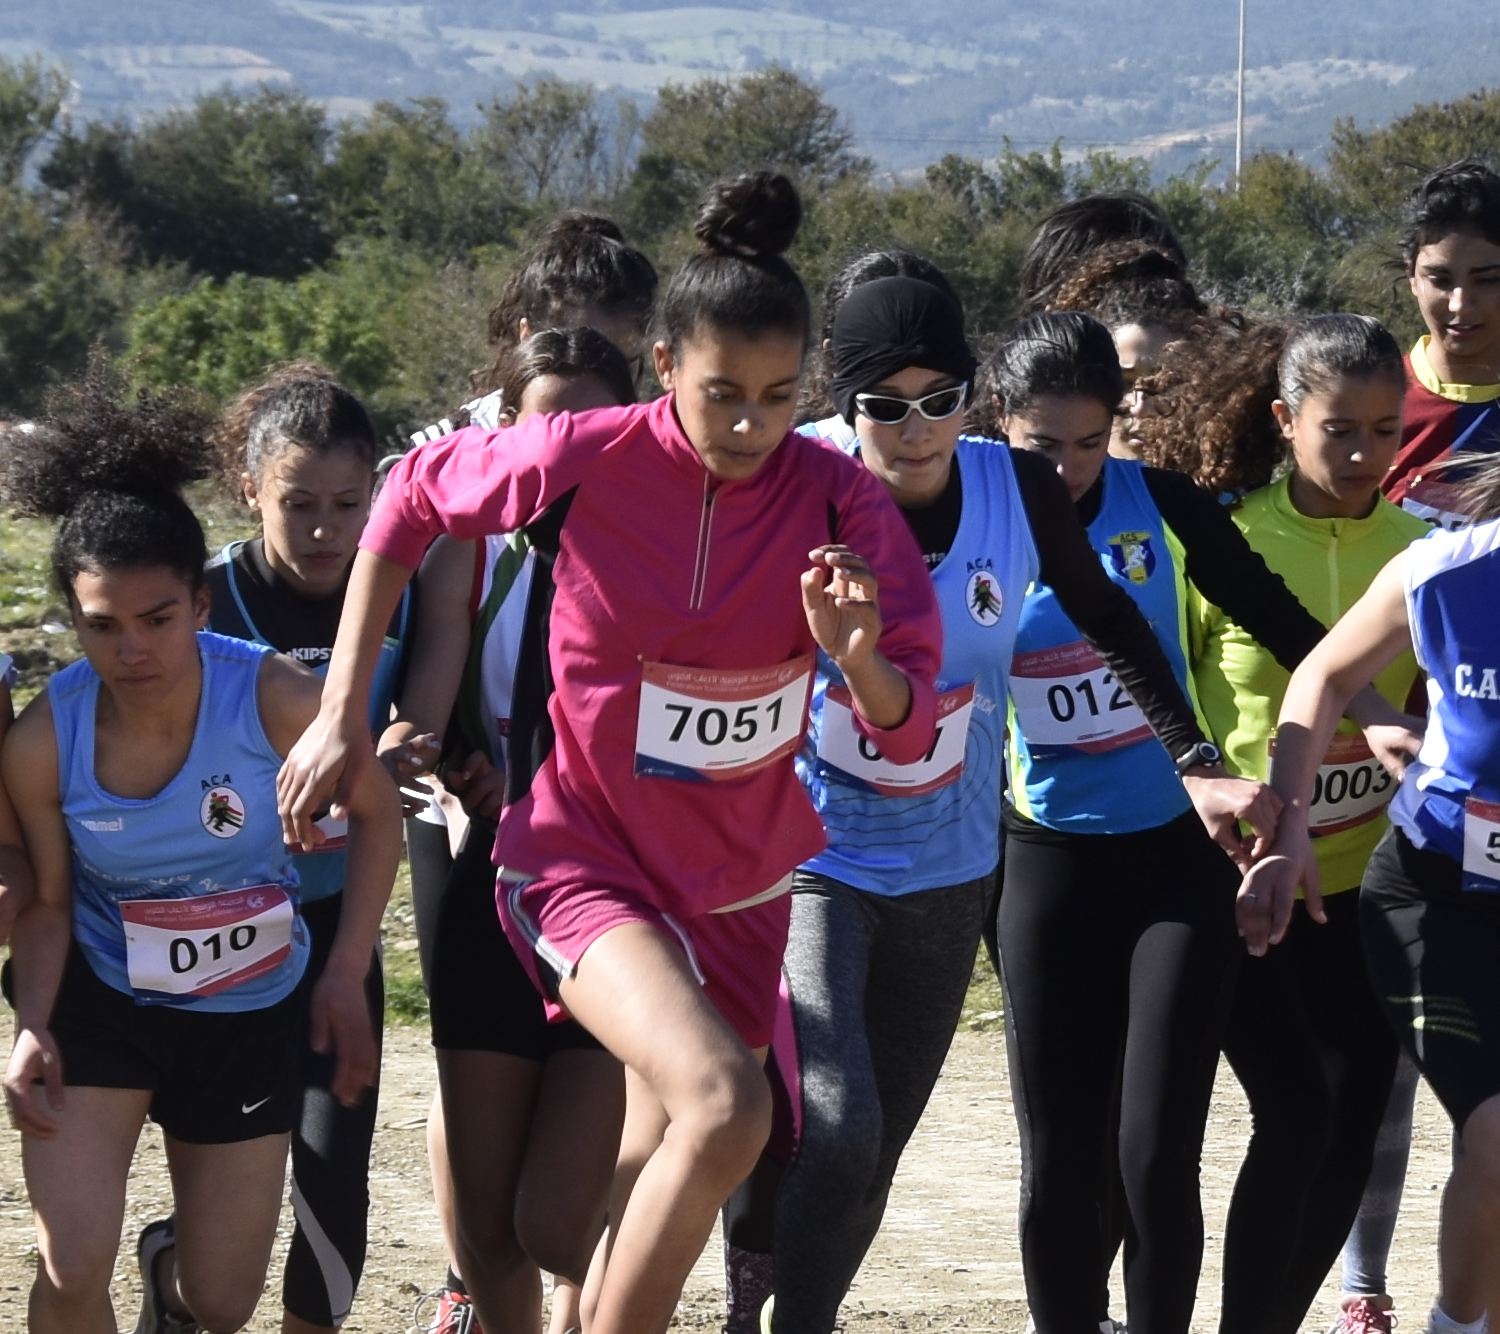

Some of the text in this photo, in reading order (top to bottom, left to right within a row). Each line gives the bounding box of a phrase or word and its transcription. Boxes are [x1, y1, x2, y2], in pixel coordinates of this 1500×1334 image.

[966, 558, 993, 574] ACA
[292, 647, 334, 660] KIPS
[1047, 672, 1134, 722] 012
[665, 696, 784, 746] 7051
[201, 773, 232, 791] ACA
[169, 924, 257, 974] 010
